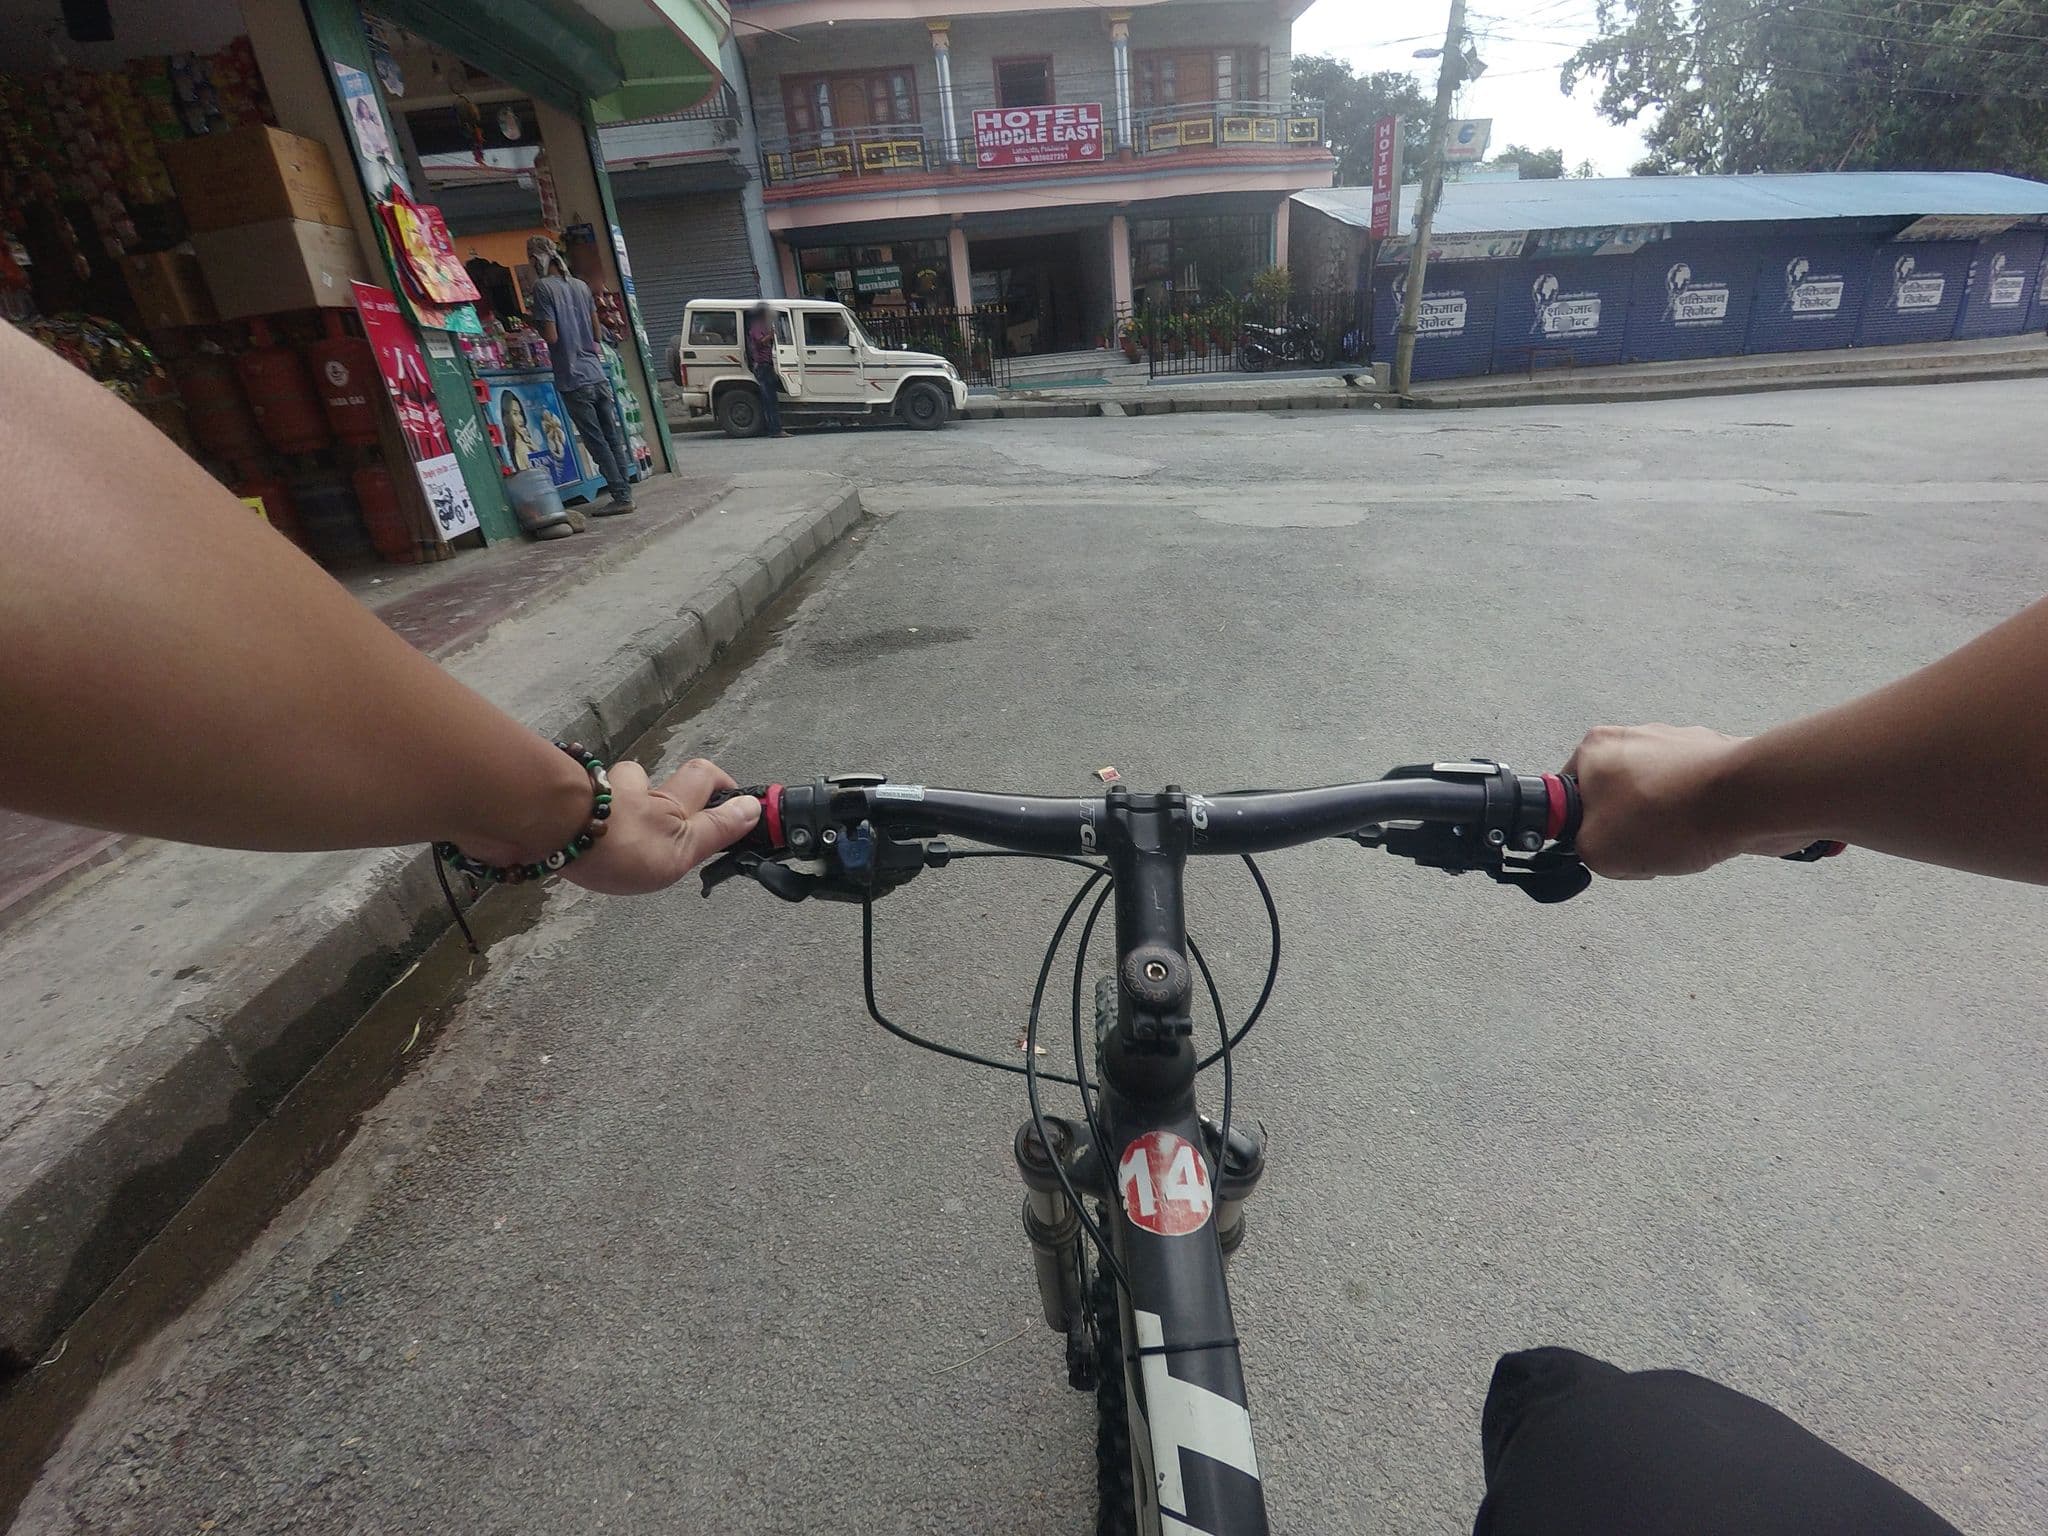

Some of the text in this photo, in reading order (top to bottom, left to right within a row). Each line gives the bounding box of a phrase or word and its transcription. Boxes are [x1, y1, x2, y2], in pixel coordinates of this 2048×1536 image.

[977, 107, 1099, 129] HOTEL
[979, 124, 1099, 147] MIDDLE EAST
[1379, 124, 1390, 189] HOTEL
[1418, 303, 1464, 315] क्तिमान
[1119, 1146, 1206, 1216] 14
